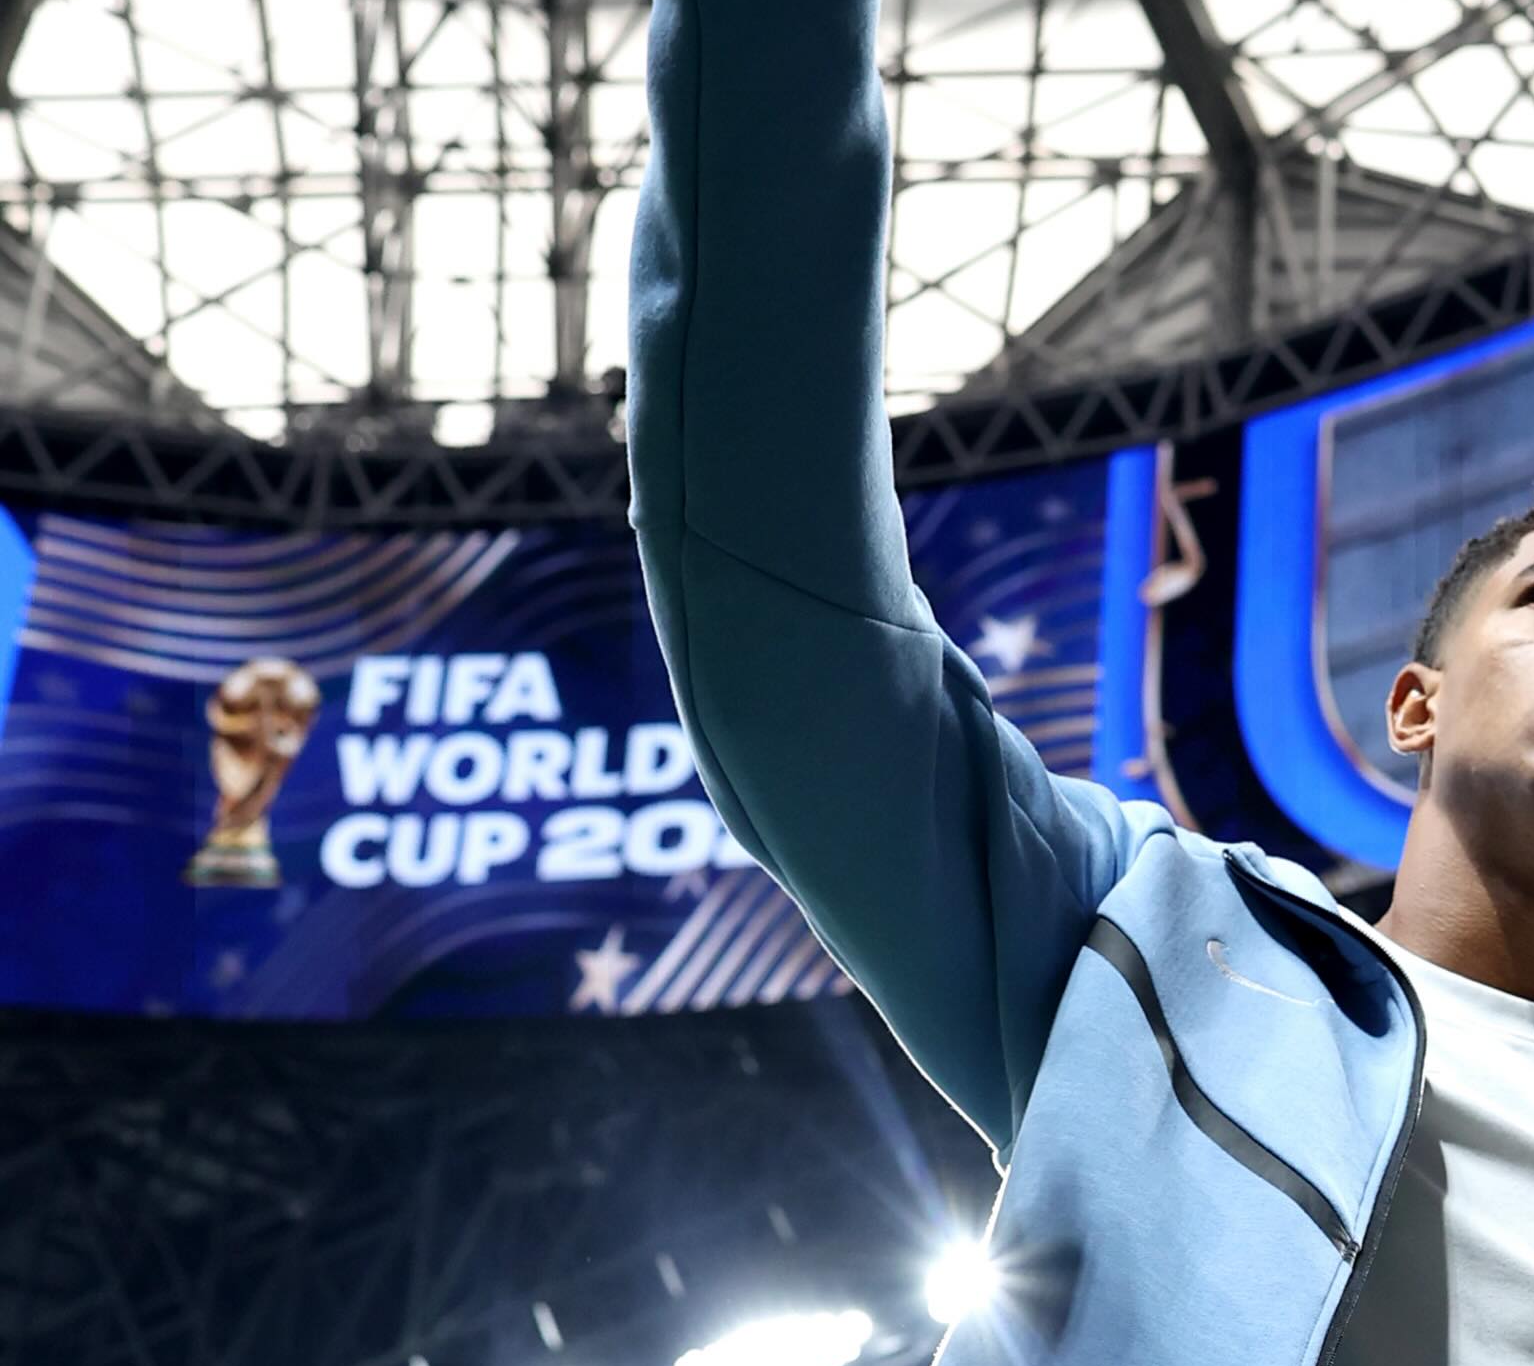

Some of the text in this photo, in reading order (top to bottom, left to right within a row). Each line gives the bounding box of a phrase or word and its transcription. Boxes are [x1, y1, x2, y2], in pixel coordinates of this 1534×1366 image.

[345, 650, 563, 727] FIFA
[336, 721, 697, 806] WORLD
[319, 798, 757, 889] CUP 20
